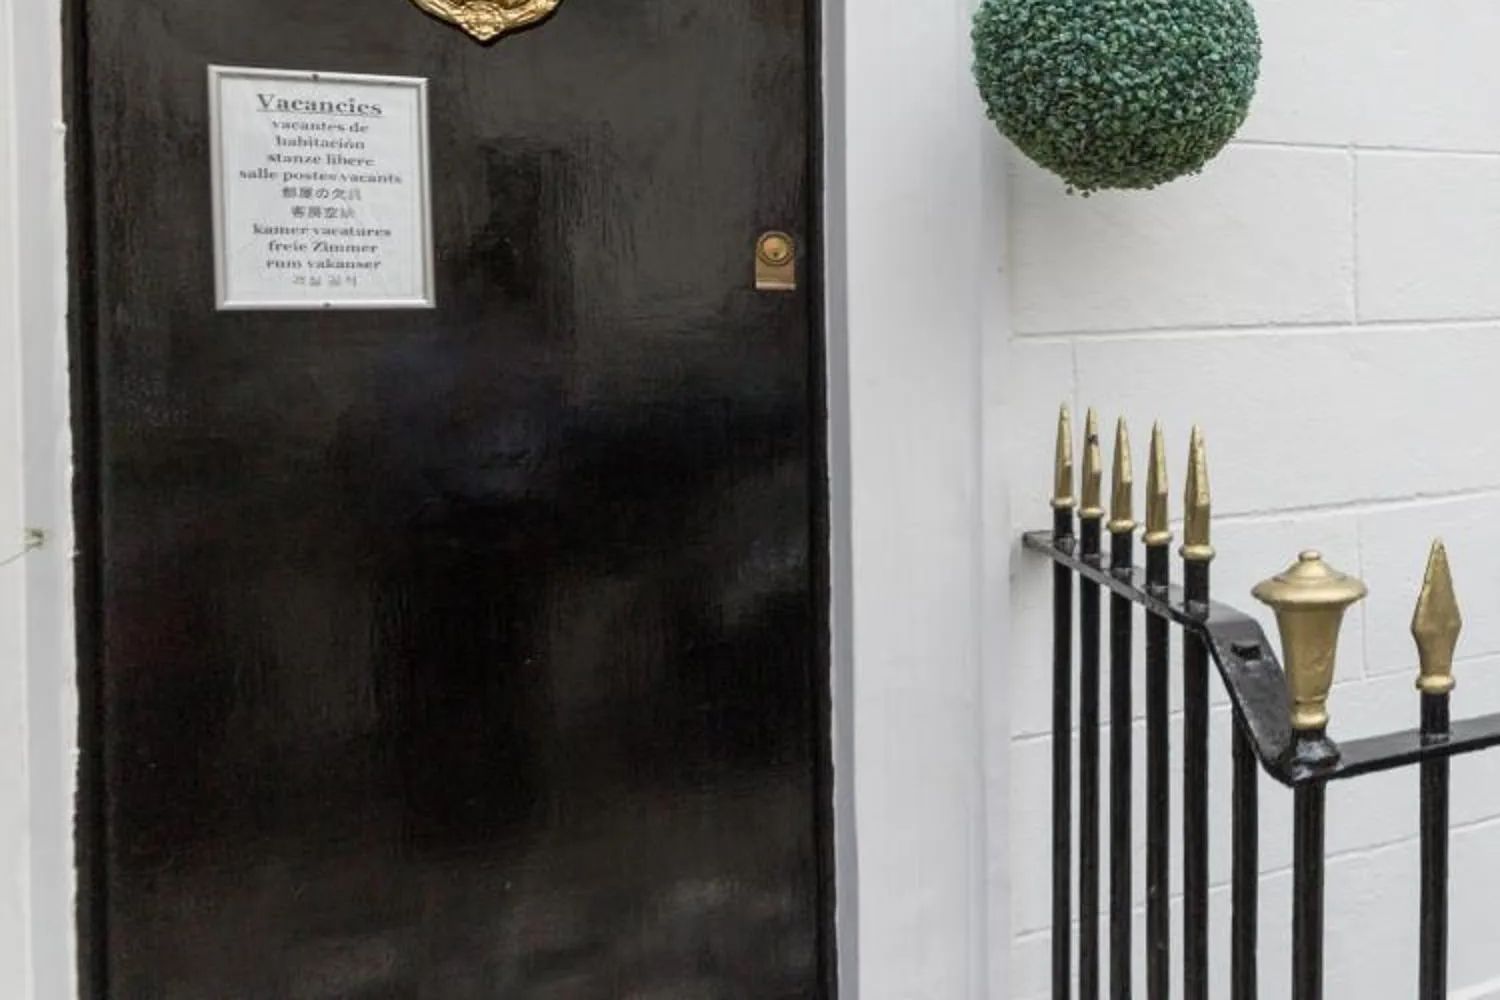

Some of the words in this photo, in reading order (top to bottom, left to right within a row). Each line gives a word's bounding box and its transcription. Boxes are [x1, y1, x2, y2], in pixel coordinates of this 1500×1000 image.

[256, 93, 383, 116] Vacancies
[272, 120, 345, 132] vacantes
[349, 121, 369, 133] de
[266, 153, 321, 165] stanze
[325, 154, 376, 167] libere
[239, 167, 278, 180] salle
[282, 170, 337, 183] postes
[340, 172, 403, 184] vacants
[252, 222, 309, 235] kamer
[312, 226, 392, 237] vacatures
[268, 239, 308, 252] freie
[312, 241, 379, 253] Zimmer
[265, 259, 302, 270] rum
[307, 258, 382, 270] vakanser
